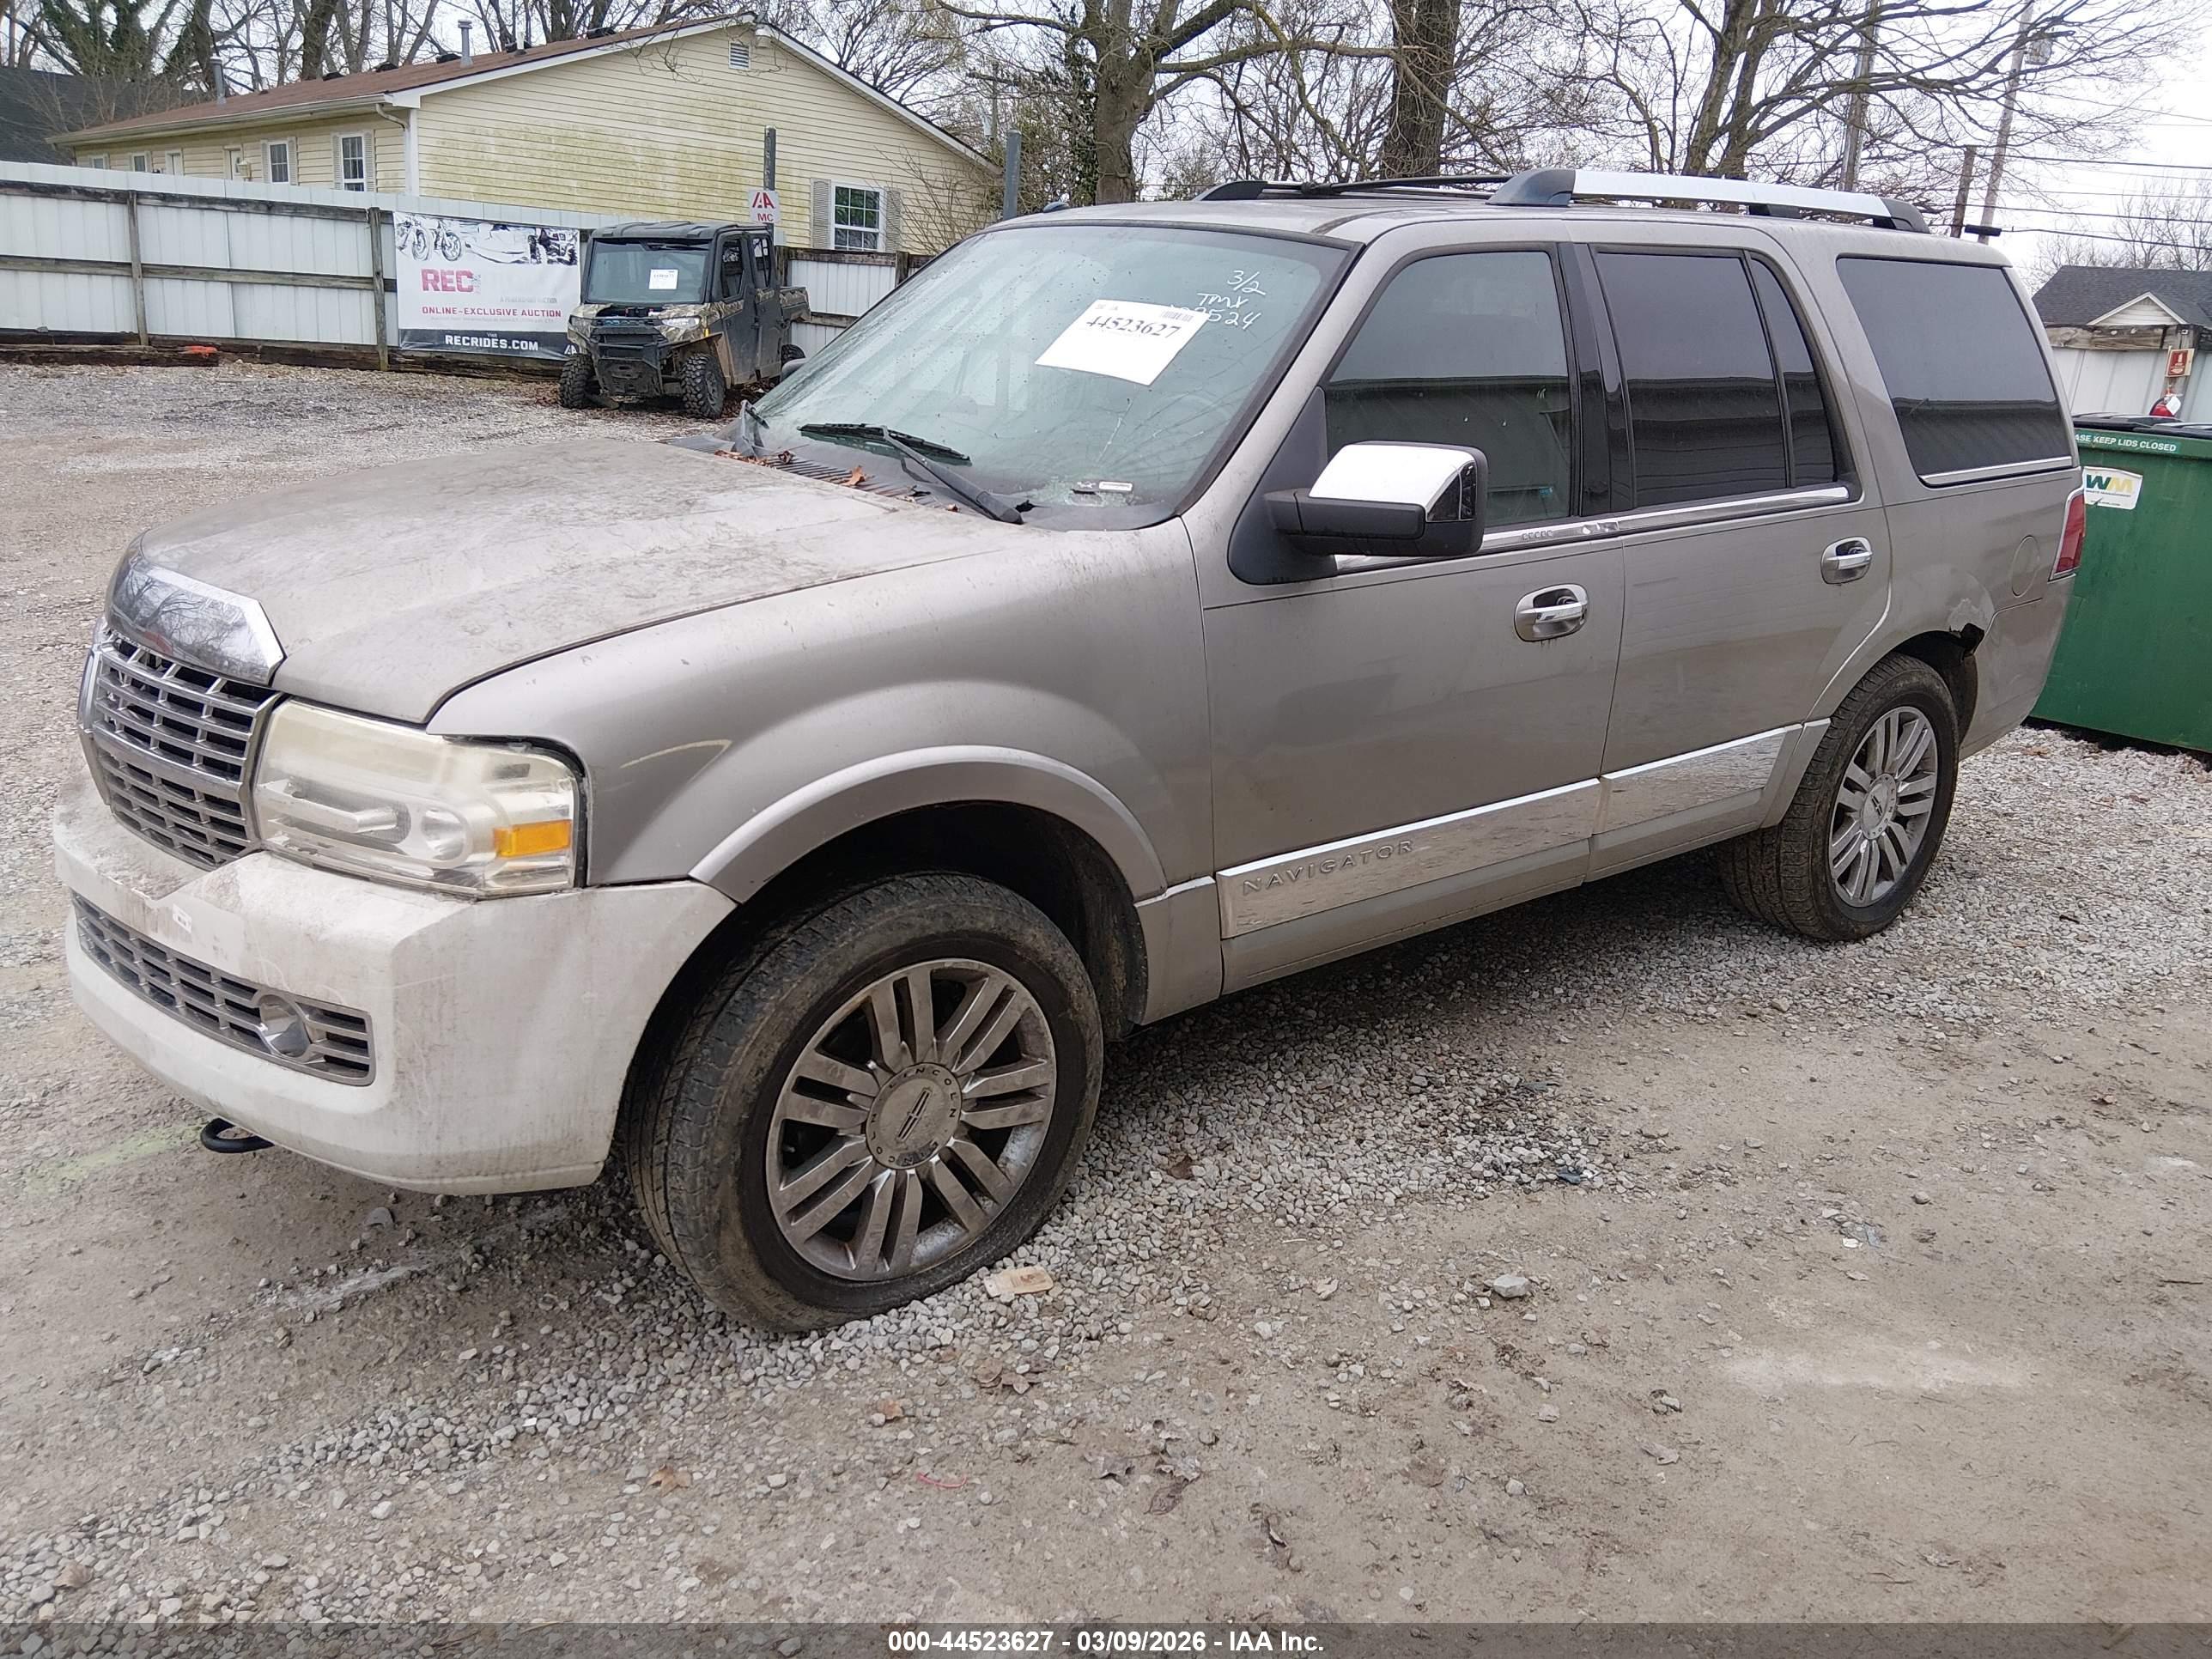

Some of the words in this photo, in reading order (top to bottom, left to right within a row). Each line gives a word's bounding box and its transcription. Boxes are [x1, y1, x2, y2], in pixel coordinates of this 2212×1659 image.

[757, 212, 775, 222] MC
[420, 268, 474, 293] REC
[1227, 270, 1266, 295] 3/2
[422, 306, 518, 317] ONLINE-EXCLUSIVE
[520, 309, 562, 318] AUCTION
[1086, 315, 1182, 338] 44523627
[445, 334, 538, 351] RECRIDES.COM
[2075, 434, 2092, 442] ASE
[2093, 435, 2117, 445] KEEP
[2118, 438, 2138, 447] LIDS
[2139, 441, 2177, 453] CLOSED
[2086, 474, 2133, 494] WM
[1243, 840, 1414, 896] NAVIGATOR
